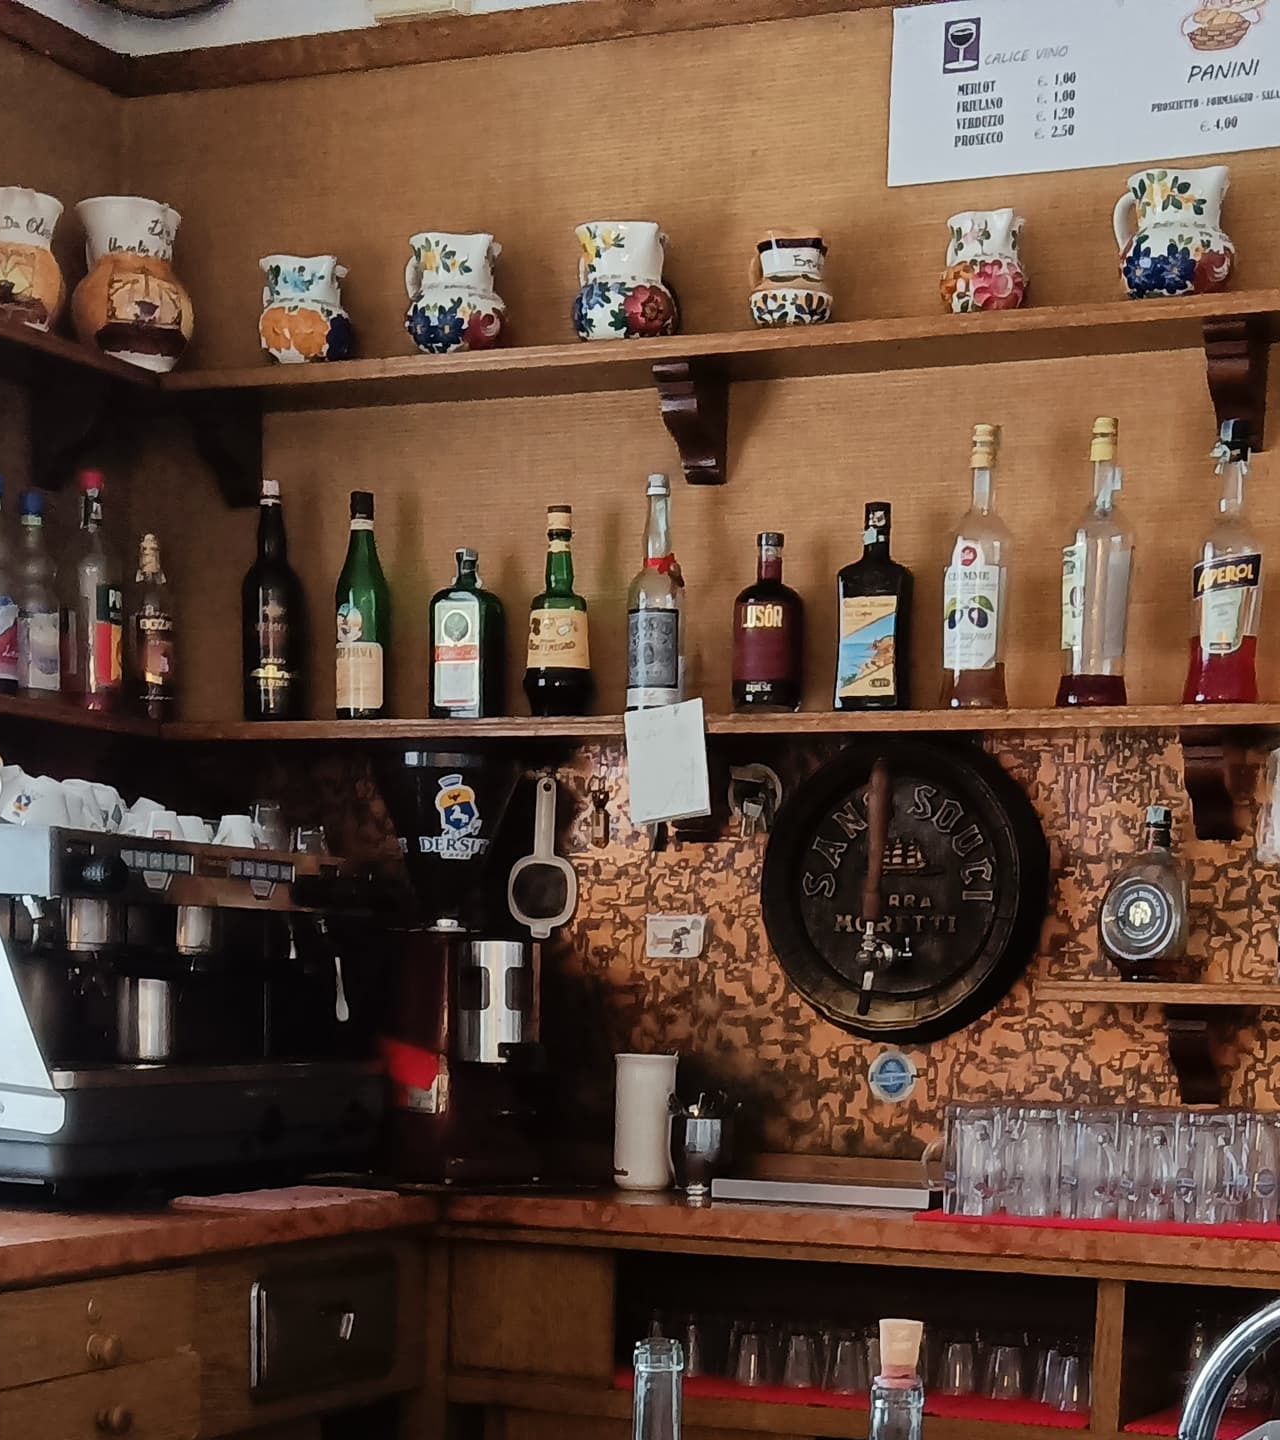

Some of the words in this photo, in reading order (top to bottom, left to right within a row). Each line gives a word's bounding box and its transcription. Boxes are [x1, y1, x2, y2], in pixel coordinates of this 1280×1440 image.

[984, 49, 1029, 66] CALICE
[1036, 45, 1069, 61] VINO
[1187, 58, 1260, 84] PANINI
[957, 80, 997, 96] MERLOT
[956, 97, 1003, 113] FRIULANO
[956, 114, 1005, 130] VERDUZZO
[954, 131, 1004, 148] PROSECCO
[1198, 563, 1255, 592] APEROL
[907, 785, 993, 901] SOUCI
